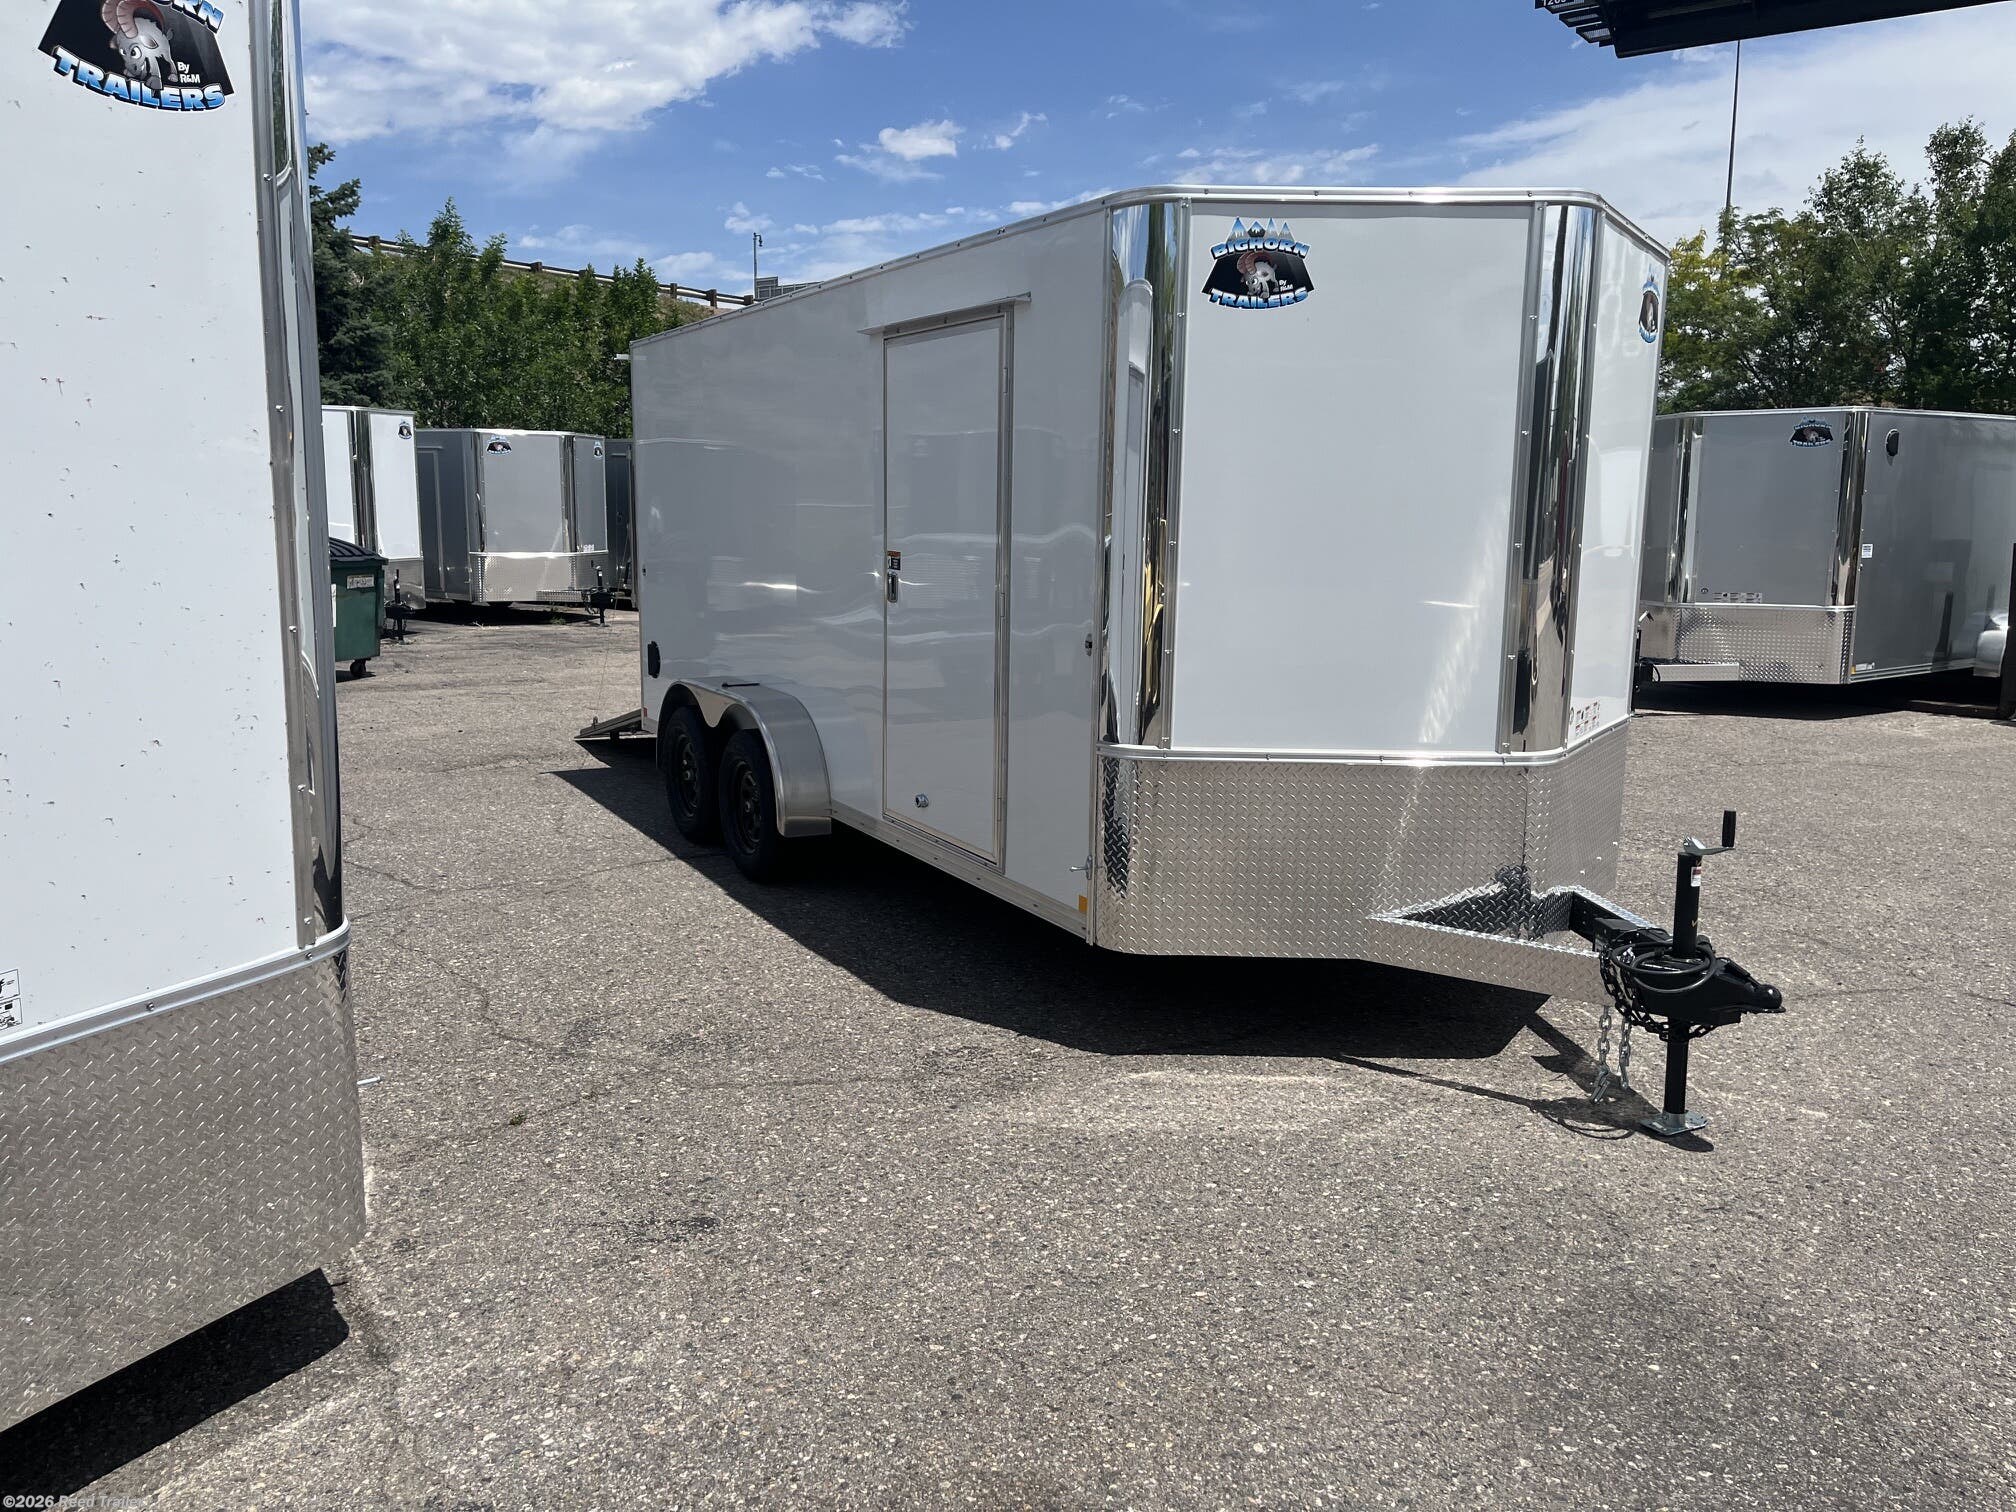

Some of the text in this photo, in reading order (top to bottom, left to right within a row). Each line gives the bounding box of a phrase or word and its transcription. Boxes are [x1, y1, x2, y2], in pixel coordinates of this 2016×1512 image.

[55, 46, 225, 109] TRAILERS
[177, 61, 190, 74] By
[179, 73, 201, 84] R&M
[1210, 238, 1310, 260] BIGHORN
[1209, 286, 1309, 309] TRAILERS
